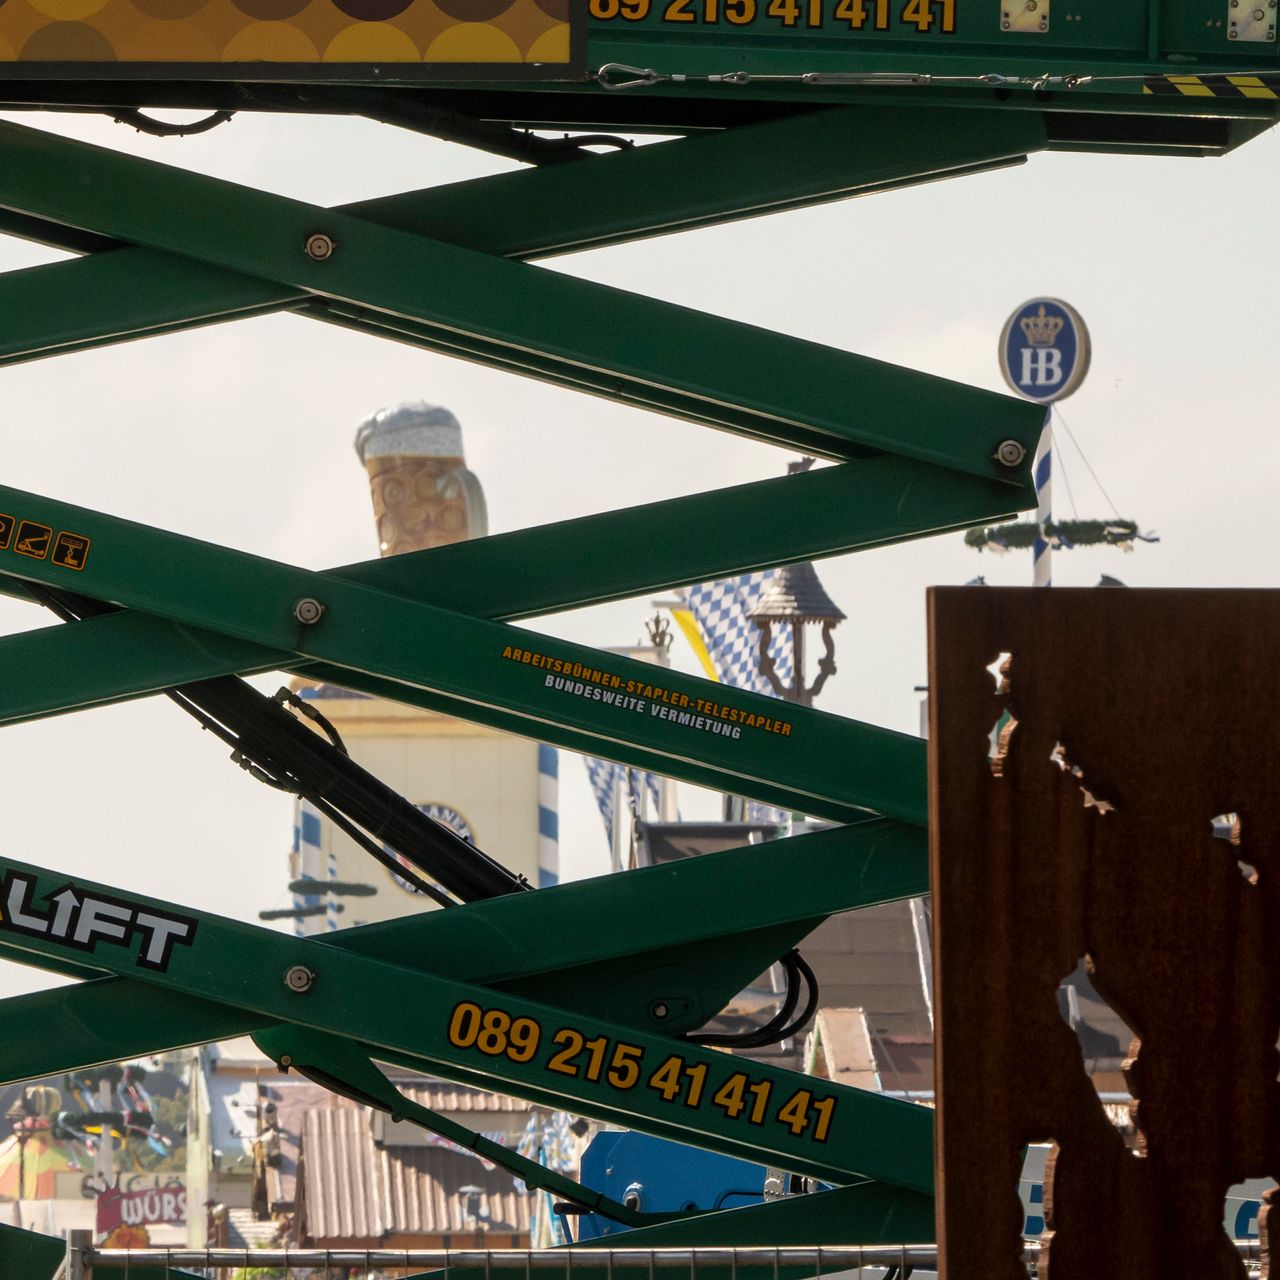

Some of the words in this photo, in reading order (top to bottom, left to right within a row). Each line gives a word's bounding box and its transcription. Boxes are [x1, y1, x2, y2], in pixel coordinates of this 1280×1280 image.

[1019, 347, 1063, 387] HB
[502, 646, 792, 737] ARBEITSBÜHNEN-STAPLER-TELESTAPLER
[545, 674, 646, 713] BUNDESWEITE
[650, 703, 743, 740] VERMIETUNG
[448, 1002, 540, 1063] 089
[548, 1030, 642, 1089] 215
[649, 1056, 707, 1107] 41
[714, 1074, 772, 1124] 41
[779, 1090, 836, 1141] 41
[121, 1191, 187, 1224] WÜRS
